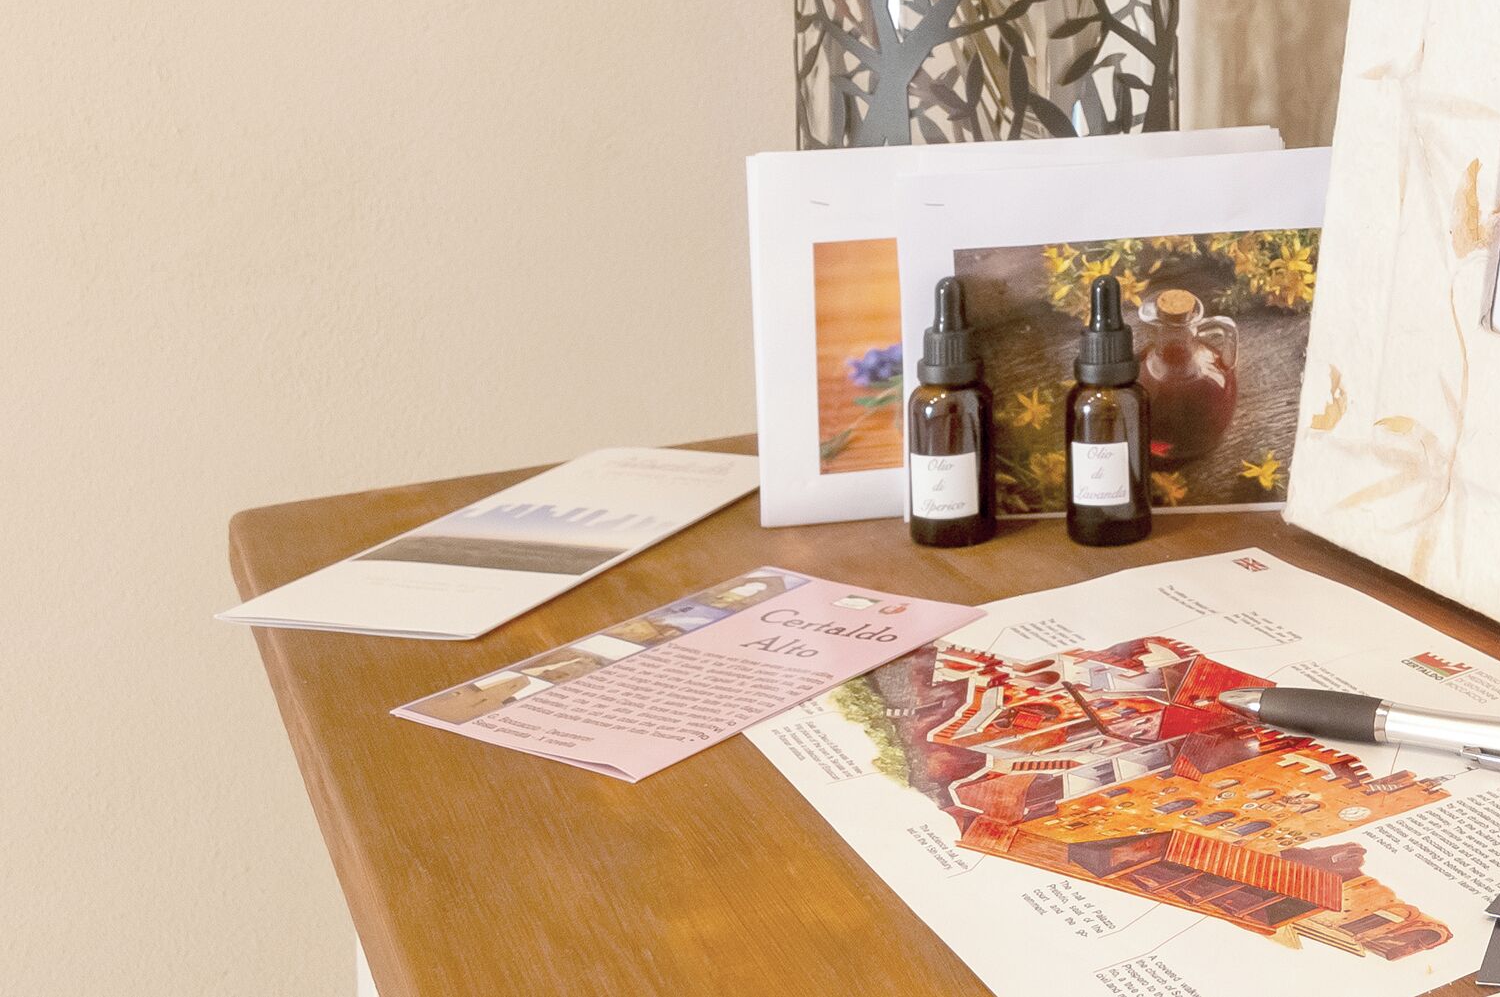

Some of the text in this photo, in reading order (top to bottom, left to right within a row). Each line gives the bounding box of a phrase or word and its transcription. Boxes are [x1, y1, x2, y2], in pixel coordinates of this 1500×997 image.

[760, 608, 898, 643] Certaldo
[740, 635, 818, 658] Alto
[1401, 659, 1443, 681] CERTALDO
[1061, 880, 1072, 890] The
[1093, 910, 1116, 930] Palazzo
[1135, 959, 1148, 969] the
[1145, 968, 1167, 985] church
[1155, 961, 1183, 982] covered
